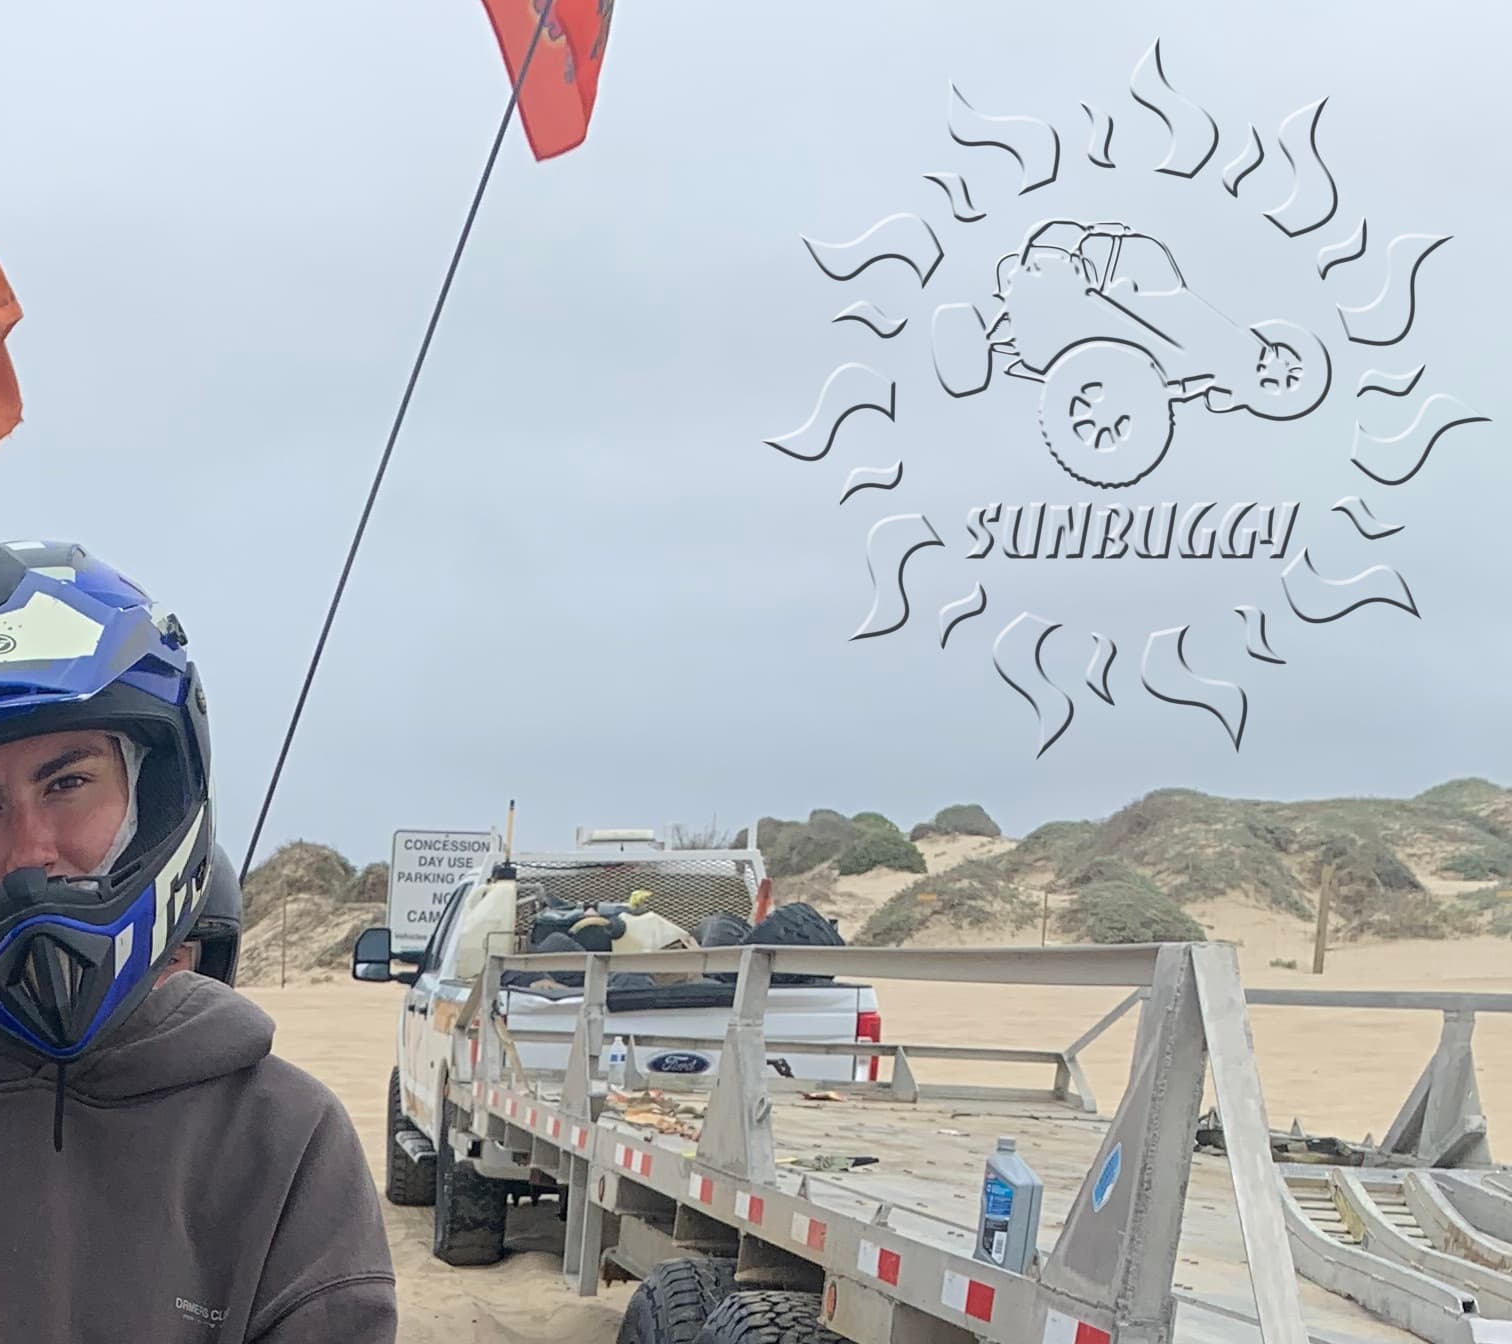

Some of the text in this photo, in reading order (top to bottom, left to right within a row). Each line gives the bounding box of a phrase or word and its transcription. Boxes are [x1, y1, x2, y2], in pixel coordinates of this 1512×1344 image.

[404, 839, 490, 853] CONCESSION
[418, 856, 473, 868] DAY USE
[397, 872, 455, 884] PARKING
[662, 1055, 697, 1071] Ford
